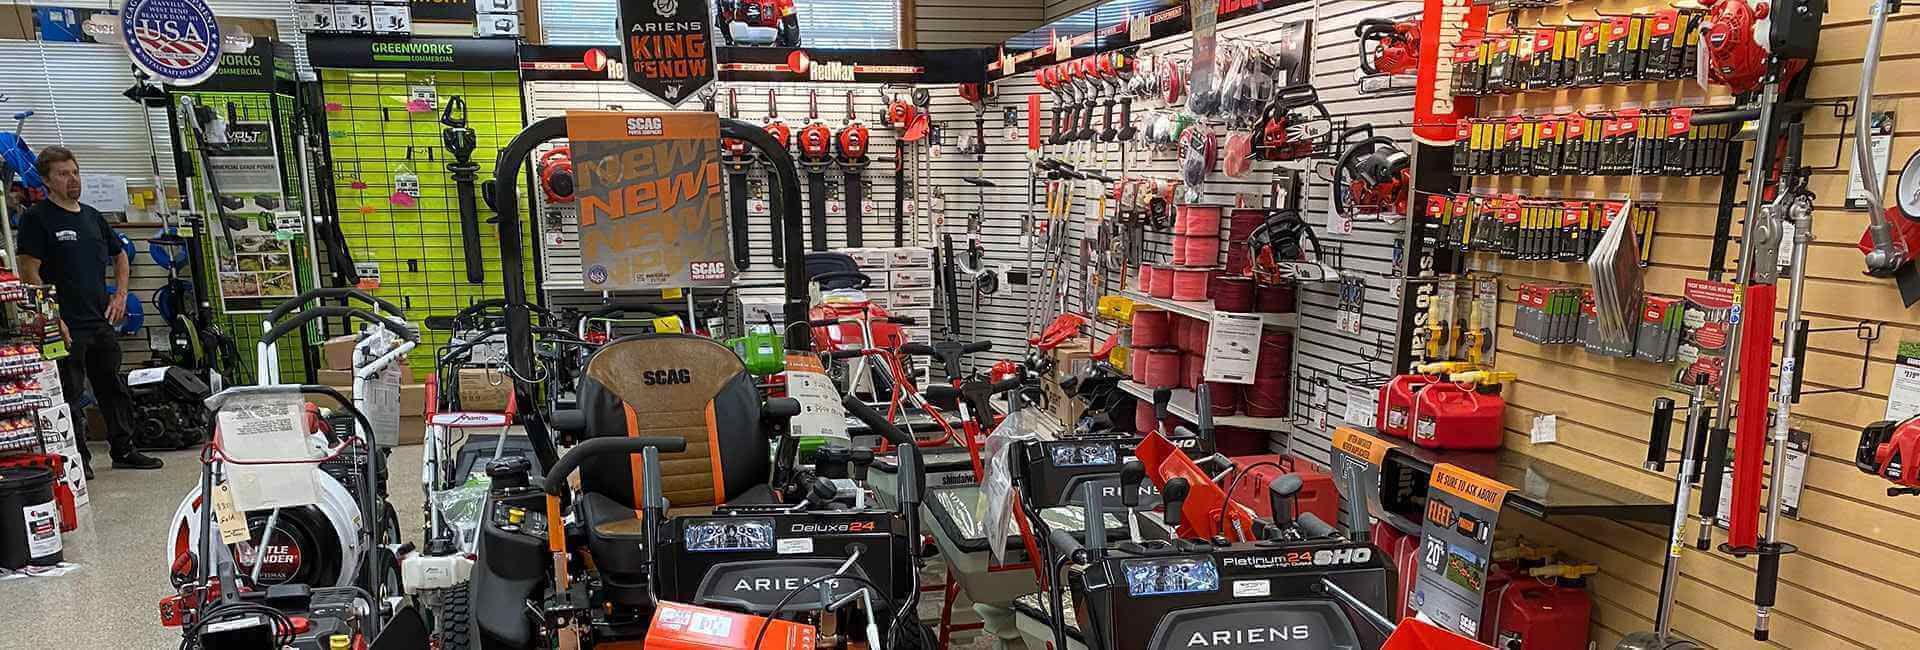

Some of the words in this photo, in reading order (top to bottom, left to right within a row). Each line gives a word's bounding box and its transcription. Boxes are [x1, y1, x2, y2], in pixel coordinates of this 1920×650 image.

[632, 21, 701, 32] ARIENS
[372, 42, 453, 55] GREENWORKS
[631, 34, 705, 59] KING
[411, 55, 454, 63] COMMERCIAL
[634, 61, 645, 72] OF
[645, 59, 706, 78] SNOW
[810, 60, 856, 80] RedMax
[628, 117, 662, 129] SCAG
[691, 263, 725, 275] SCAG
[643, 368, 691, 385] SCAG
[1444, 473, 1456, 489] SURE
[1457, 480, 1465, 492] TO
[1465, 482, 1477, 497] ASK
[1477, 487, 1498, 504] ABOUT
[850, 521, 876, 531] 24
[1224, 556, 1286, 566] Platinum
[1287, 552, 1312, 563] 24
[1313, 547, 1372, 566] SHO
[1187, 625, 1309, 647] ARIENS
